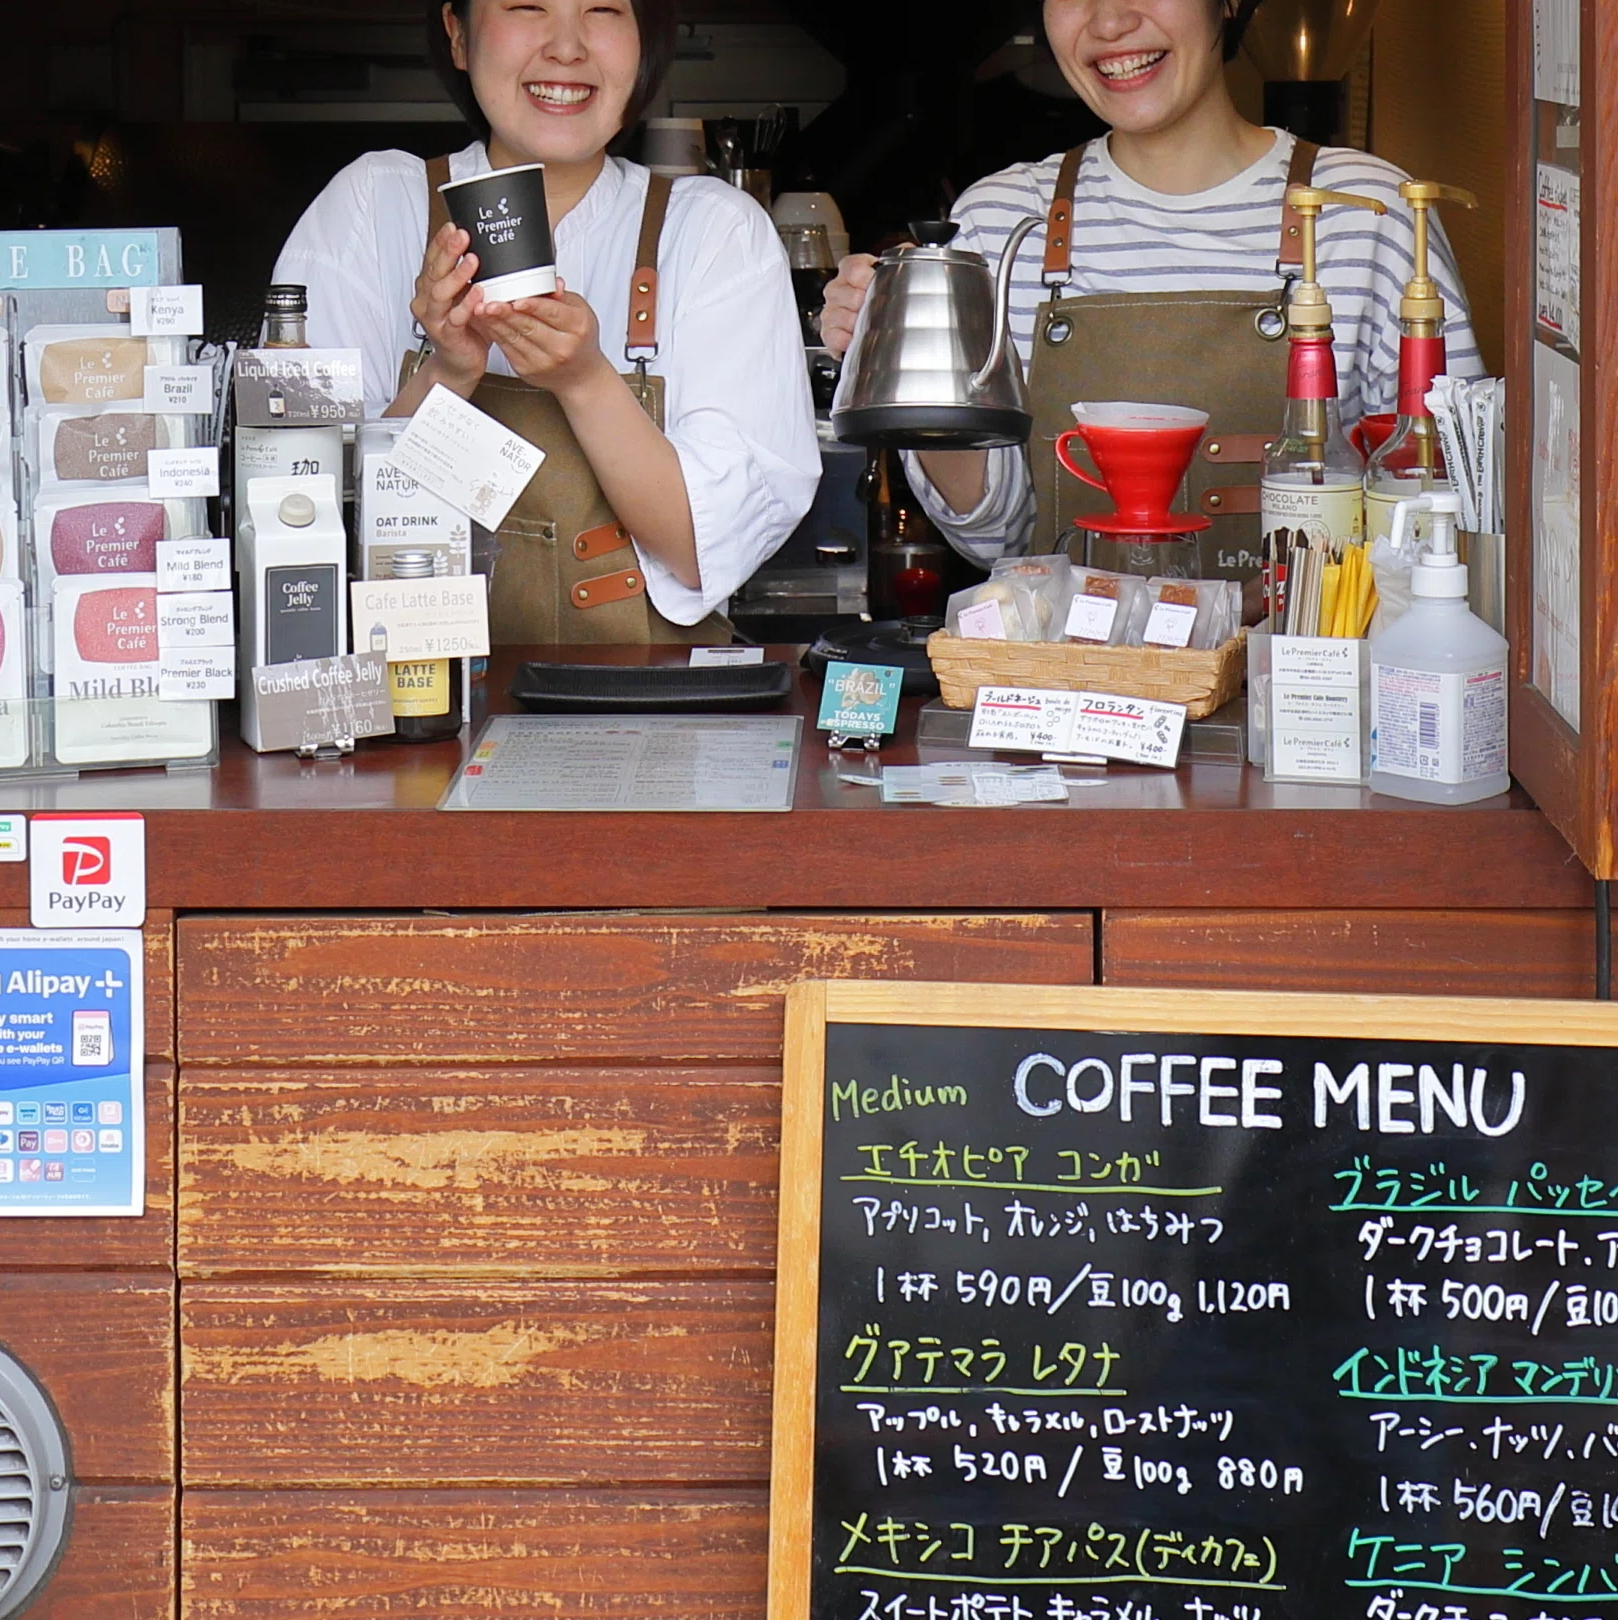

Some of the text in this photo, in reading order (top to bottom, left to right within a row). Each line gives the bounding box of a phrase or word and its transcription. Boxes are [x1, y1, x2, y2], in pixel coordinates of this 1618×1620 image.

[478, 207, 493, 220] Le
[476, 216, 523, 235] Premier
[489, 229, 515, 245] Café
[66, 243, 145, 279] BAG
[151, 305, 184, 315] Kenya
[164, 384, 192, 393] Brazil
[160, 468, 210, 478] Indonesia
[1262, 491, 1318, 505] CHOCOLATE
[376, 516, 438, 526] OAT DRINK
[92, 523, 107, 537] Le
[86, 538, 139, 553] Premier
[98, 553, 128, 568] Café
[167, 560, 223, 570] Mild Blend
[282, 580, 319, 594] Coffee
[287, 593, 314, 607] Jelly
[365, 590, 473, 610] Cafe Latte Base
[161, 614, 228, 627] Strong Blend
[394, 663, 436, 675] LATTE
[258, 660, 382, 696] Crushed Coffee Jelly
[397, 676, 433, 689] BASE
[69, 679, 122, 701] Mild
[1083, 698, 1144, 715] フロランタン
[834, 710, 880, 721] TODAYS
[826, 718, 885, 730] ESPRESSO
[48, 891, 126, 914] PayPay
[9, 1012, 53, 1024] smart
[17, 1031, 45, 1042] your
[6, 1043, 63, 1054] e-wallets
[832, 1075, 967, 1121] Medium
[1013, 1052, 1525, 1137] COFFEE MENU
[857, 1141, 1161, 1183] エチオピア コンガ
[1333, 1156, 1480, 1208] ブラジル
[845, 1324, 1121, 1386] グアテマラ レタナ
[1333, 1346, 1497, 1395] インドネシア
[835, 1512, 974, 1564] メキシコ
[1349, 1527, 1466, 1587] ケニア
